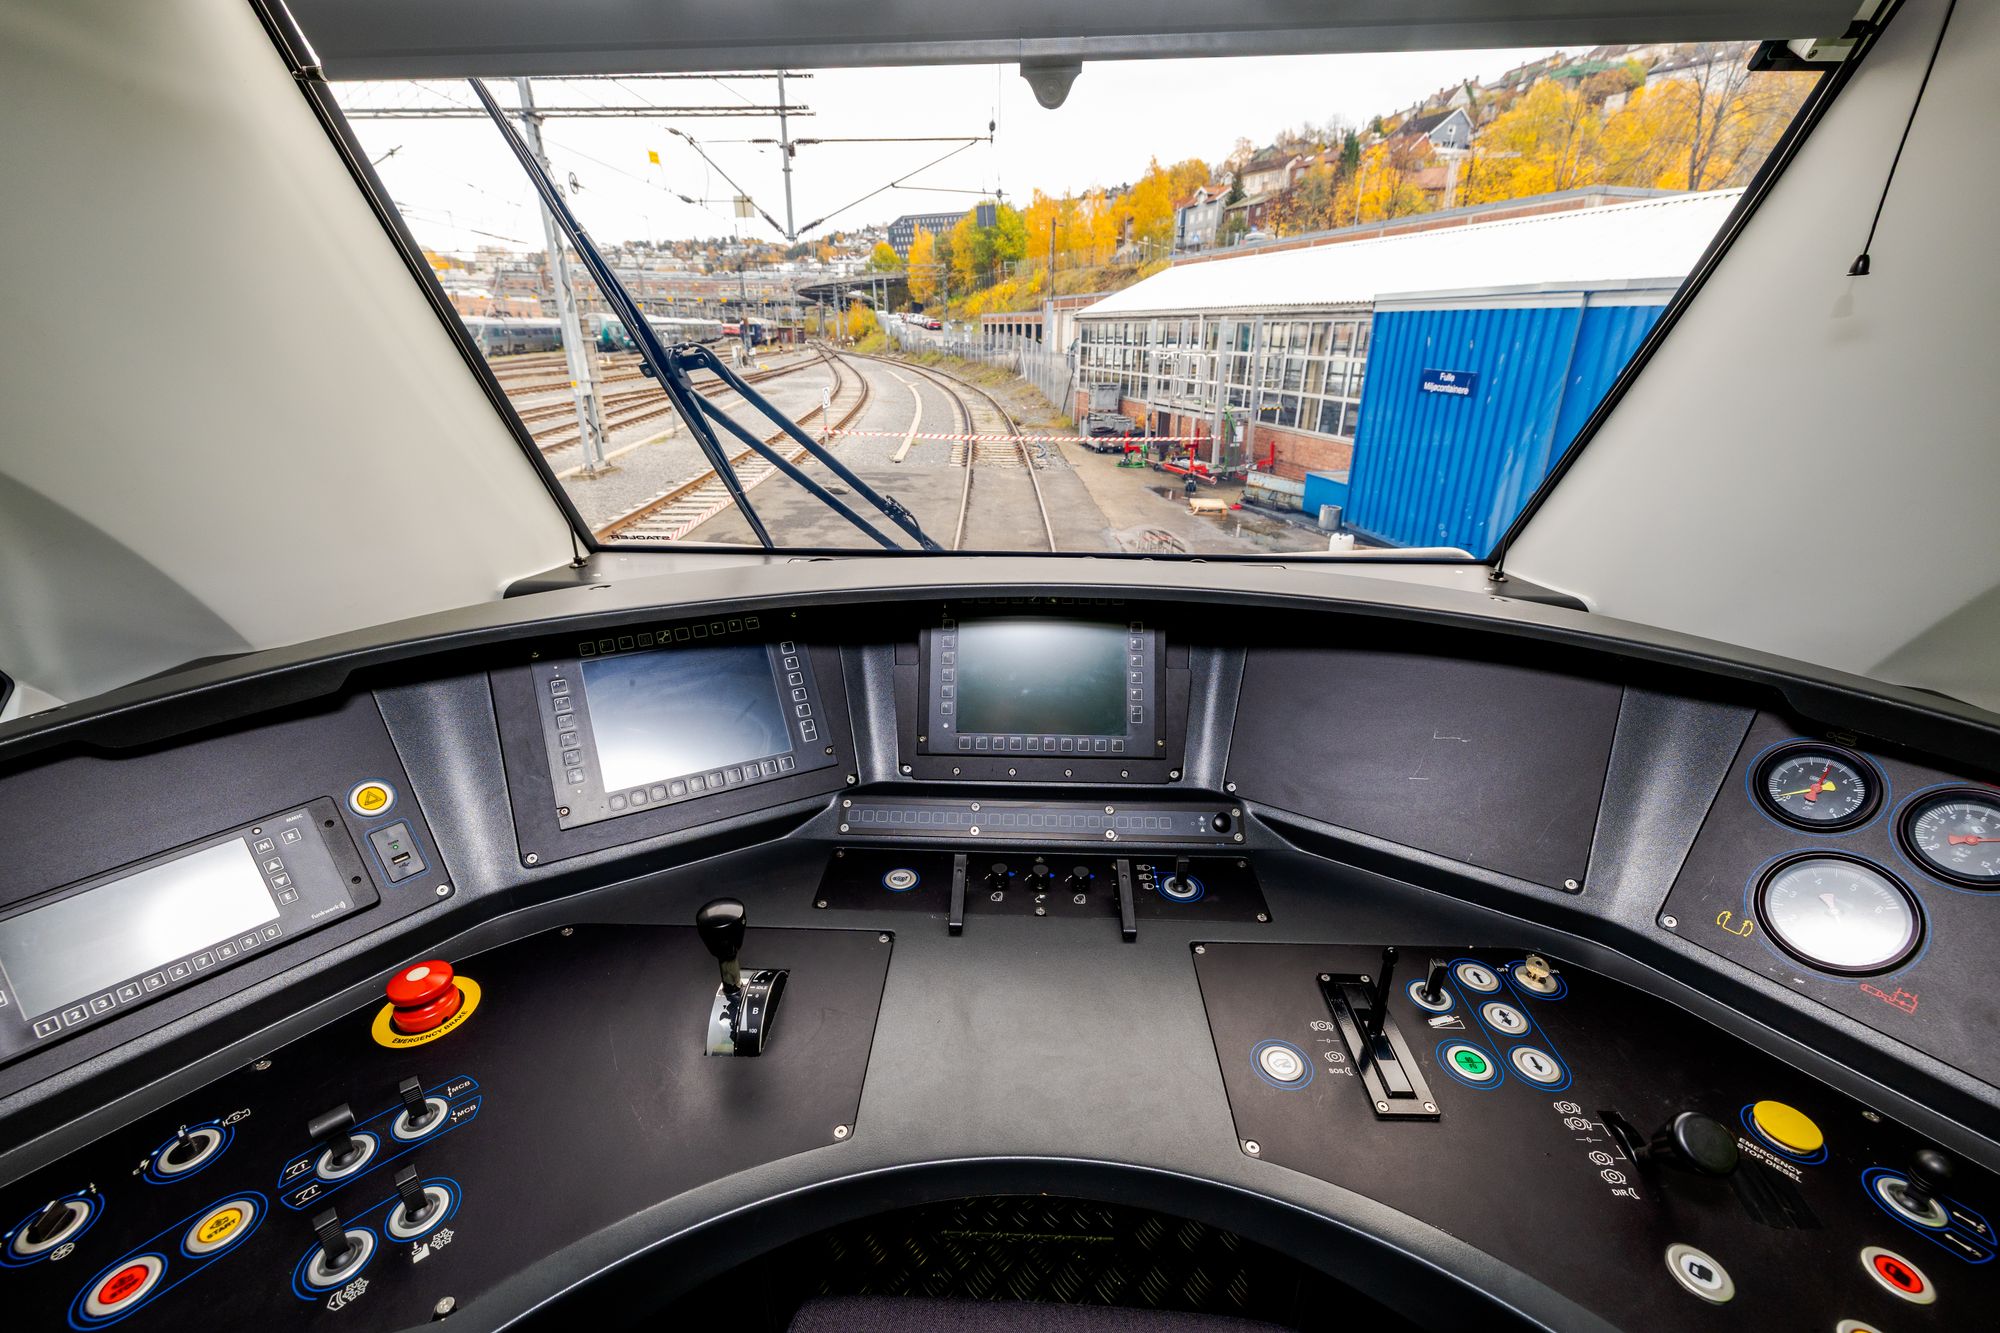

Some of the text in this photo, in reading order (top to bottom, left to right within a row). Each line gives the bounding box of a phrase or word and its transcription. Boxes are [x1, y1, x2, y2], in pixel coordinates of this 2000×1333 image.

[287, 832, 296, 840] R
[259, 842, 270, 850] M
[1850, 884, 1858, 892] 5
[1789, 890, 1797, 898] 3
[311, 904, 340, 920] funkwerk
[1874, 905, 1884, 914] 6
[268, 928, 276, 936] 0
[246, 938, 253, 946] 9
[222, 947, 232, 956] 8
[199, 957, 208, 966] 7
[176, 966, 184, 976] 6
[150, 978, 160, 986] 5
[124, 988, 134, 997] 4
[98, 999, 108, 1008] 3
[70, 1011, 82, 1020] 2
[752, 1007, 760, 1015] B
[43, 1022, 50, 1032] 1
[392, 1010, 468, 1044] EMERGENCY BRAKE
[452, 1080, 472, 1092] MCB
[457, 1104, 477, 1117] MCB
[1738, 1136, 1803, 1176] EMERGENCY
[1736, 1142, 1802, 1184] STOP DIESEL
[1612, 1188, 1630, 1197] DIR
[206, 1218, 238, 1240] START
[110, 1278, 140, 1300] STOP
